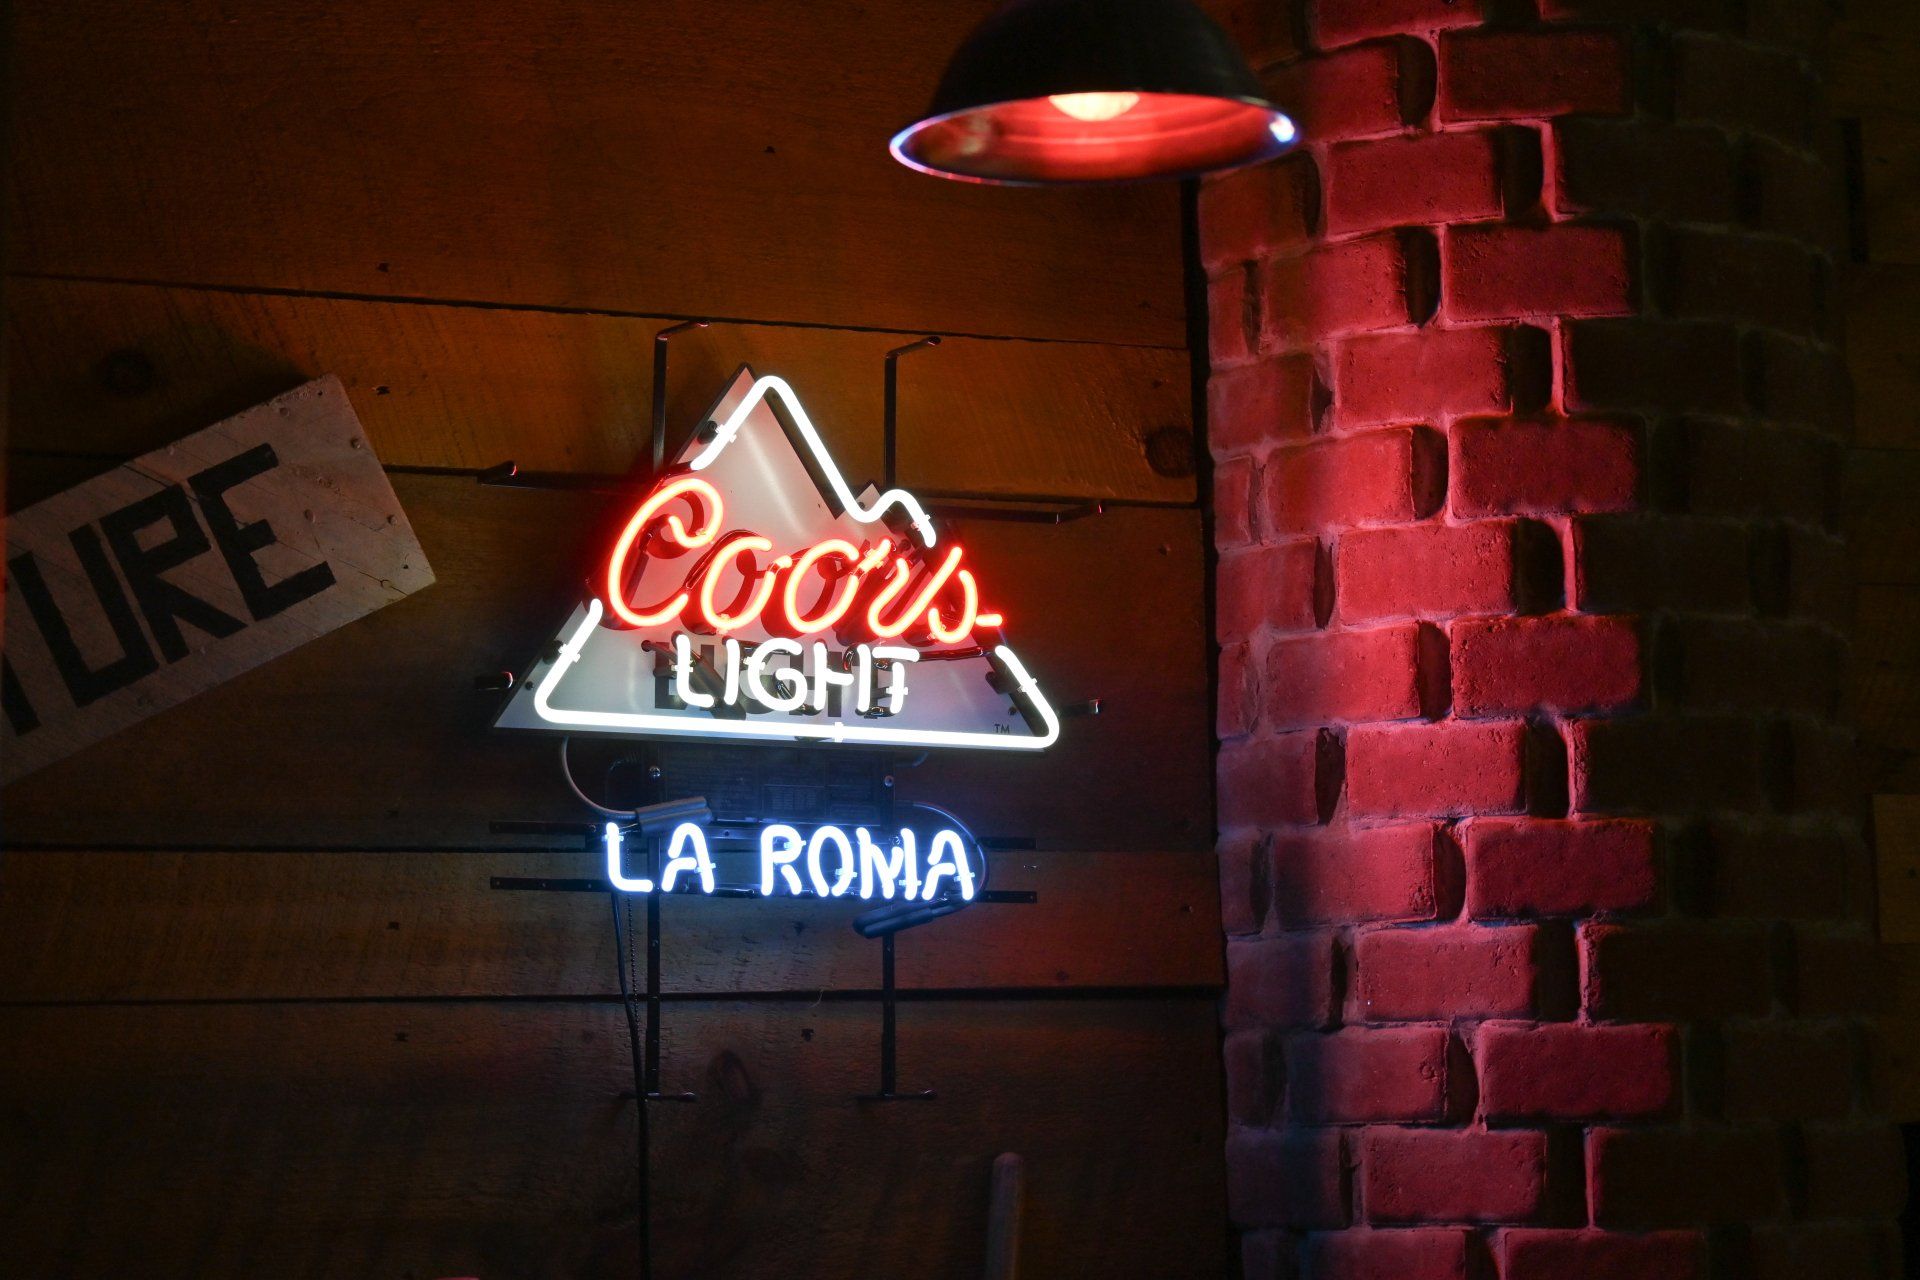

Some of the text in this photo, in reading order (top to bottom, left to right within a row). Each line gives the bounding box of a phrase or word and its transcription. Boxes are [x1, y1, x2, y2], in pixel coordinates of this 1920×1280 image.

[606, 477, 1003, 645] Coors
[675, 634, 920, 714] LIGHT
[605, 821, 975, 901] LA ROMA
